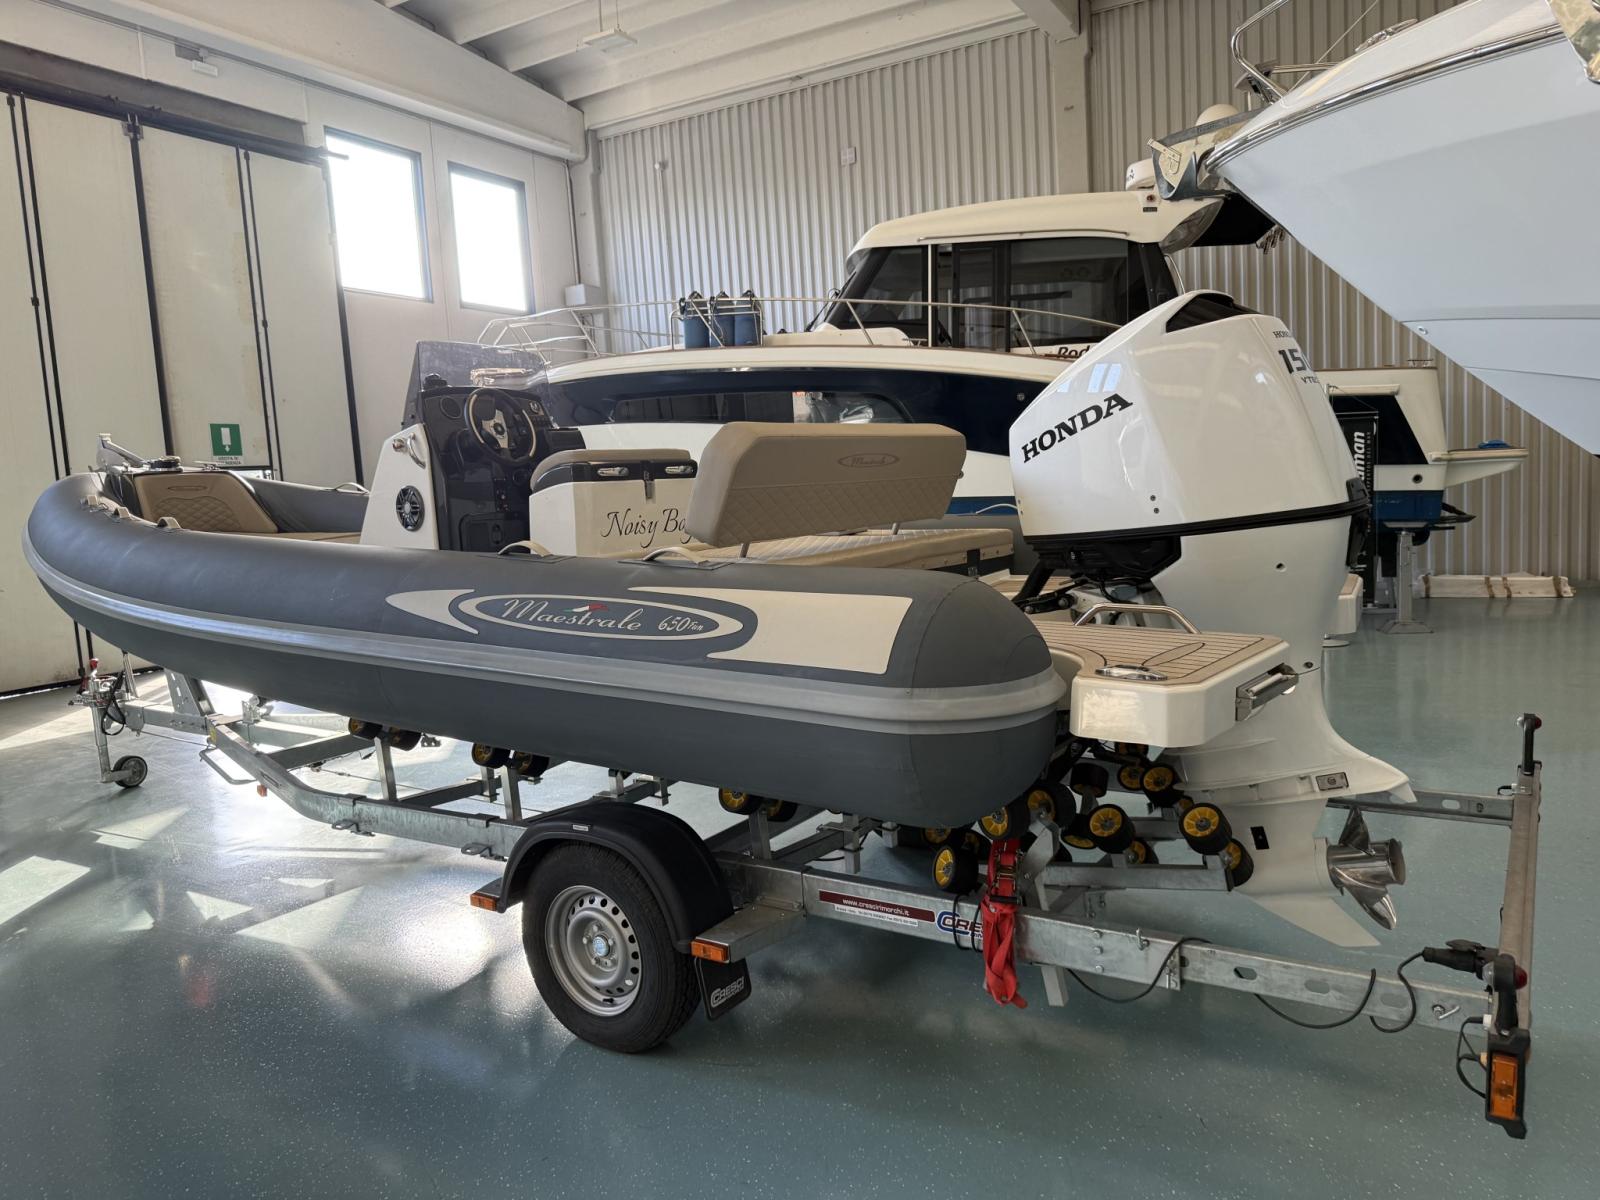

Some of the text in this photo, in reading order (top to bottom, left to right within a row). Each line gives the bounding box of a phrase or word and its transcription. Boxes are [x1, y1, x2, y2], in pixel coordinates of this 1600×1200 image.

[1278, 348, 1311, 374] 15
[1021, 393, 1134, 464] HONDA
[601, 508, 658, 549] Noisy
[501, 599, 644, 632] Maestrale
[937, 911, 983, 936] CRE
